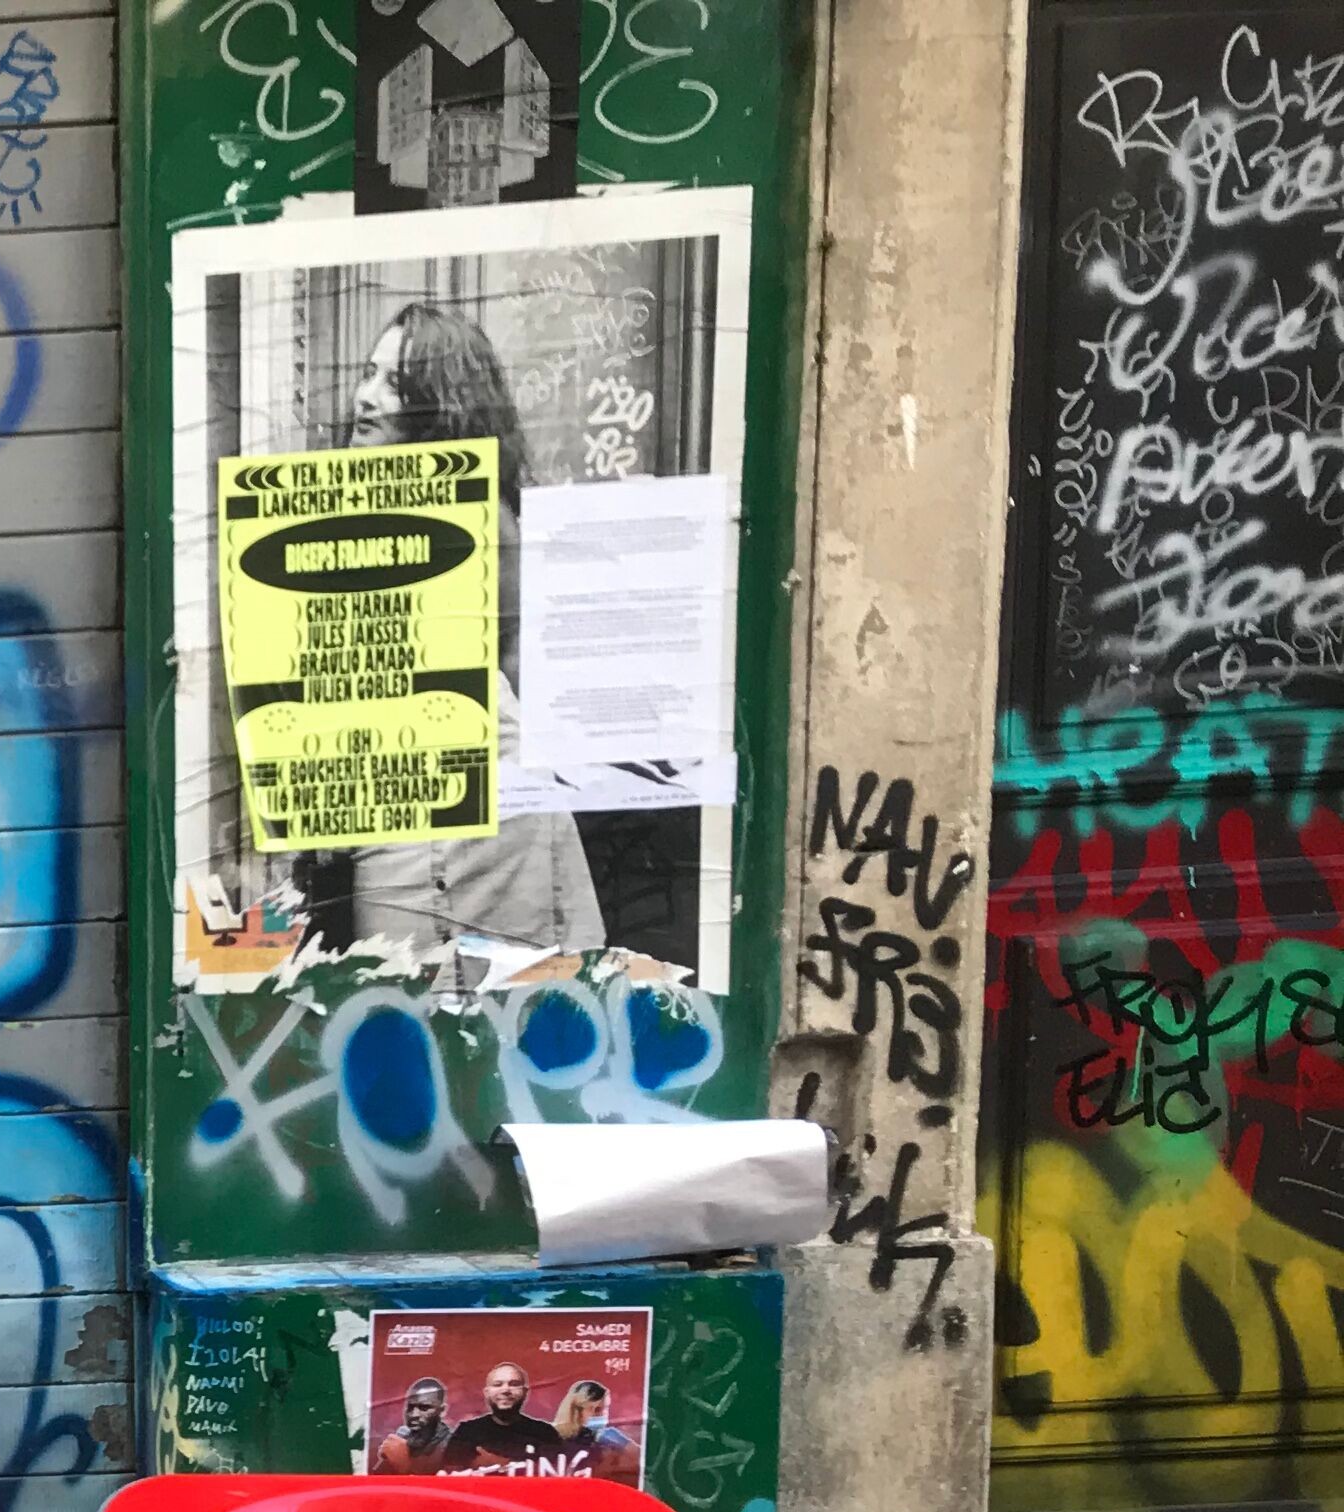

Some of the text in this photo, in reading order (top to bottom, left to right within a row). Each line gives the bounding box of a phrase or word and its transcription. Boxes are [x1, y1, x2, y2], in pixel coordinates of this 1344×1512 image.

[347, 453, 423, 483] NOVEMBRE
[263, 489, 344, 518] LANCEMENT
[366, 480, 452, 510] VERNISSAGE
[284, 533, 431, 574] BICEPS FRANCE 2021
[306, 597, 347, 623] CHRIS
[307, 618, 409, 650] JULES JANSSEN
[299, 645, 415, 678] BRAULIO AMADO
[308, 672, 409, 704] JULIEN GOBLED
[288, 751, 428, 786] BOUCHERIE BANANE
[292, 786, 319, 811] RUE
[323, 783, 356, 809] JEAN
[373, 775, 451, 805] BERNARDY
[300, 807, 376, 838] MARSEILLE
[388, 1334, 434, 1347] Kazib
[539, 1339, 630, 1352] 4 DECEMBRE
[576, 1324, 631, 1336] SAMEDI
